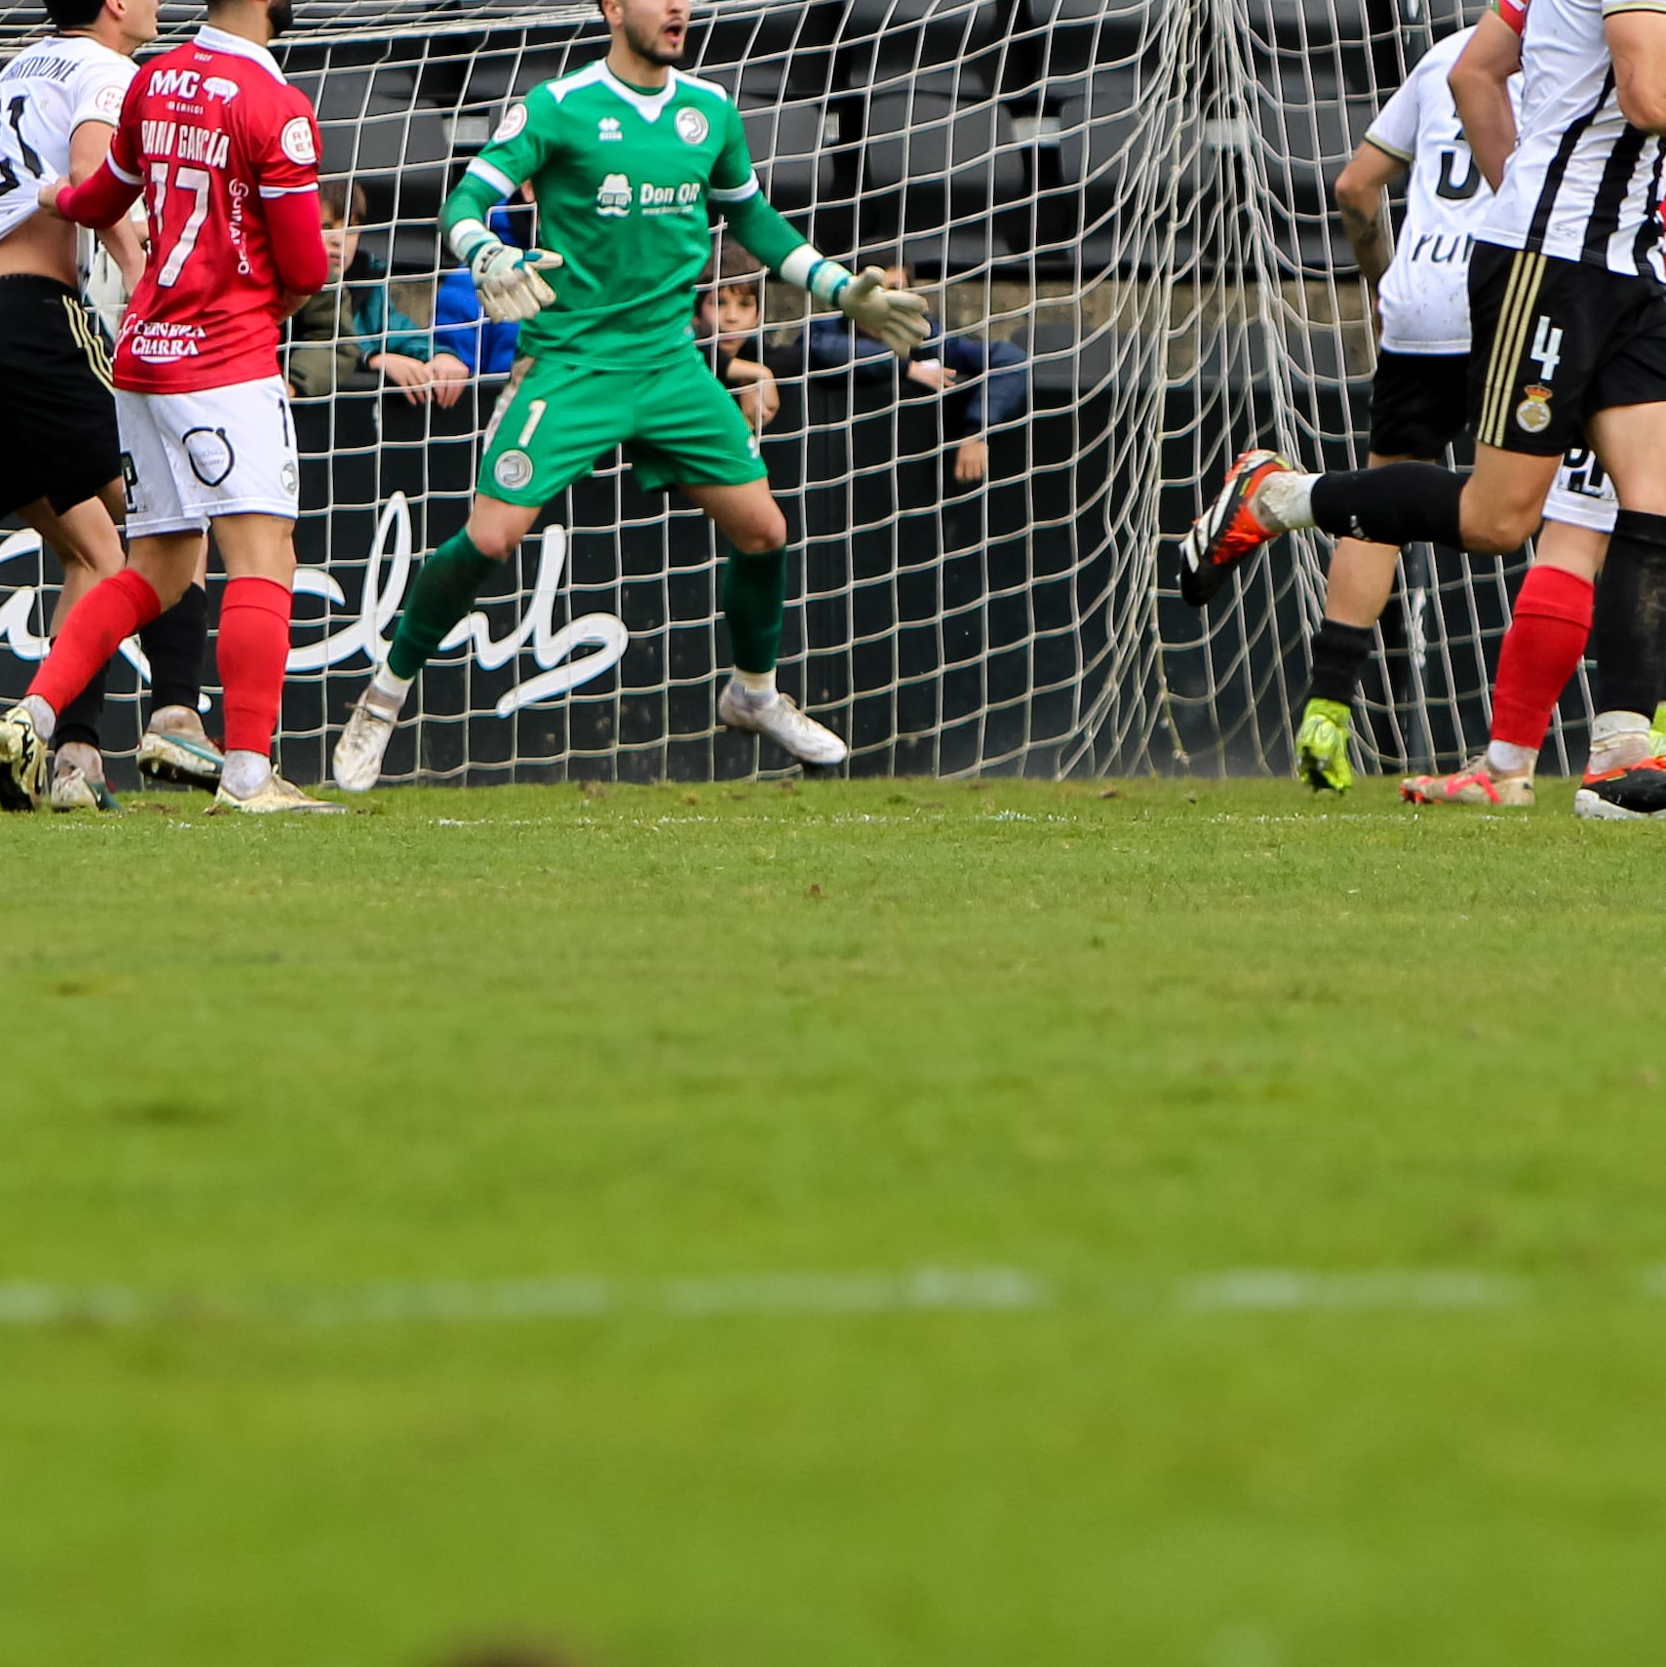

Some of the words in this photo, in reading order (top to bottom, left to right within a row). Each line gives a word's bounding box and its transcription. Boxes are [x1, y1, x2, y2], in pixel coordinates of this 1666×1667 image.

[147, 68, 201, 100] MMG
[176, 127, 231, 170] GARCÍA
[640, 182, 675, 205] Don
[677, 182, 701, 204] QR
[149, 161, 211, 289] 17
[131, 335, 200, 357] CHARRA
[1529, 314, 1564, 381] 4
[517, 399, 548, 448] 1
